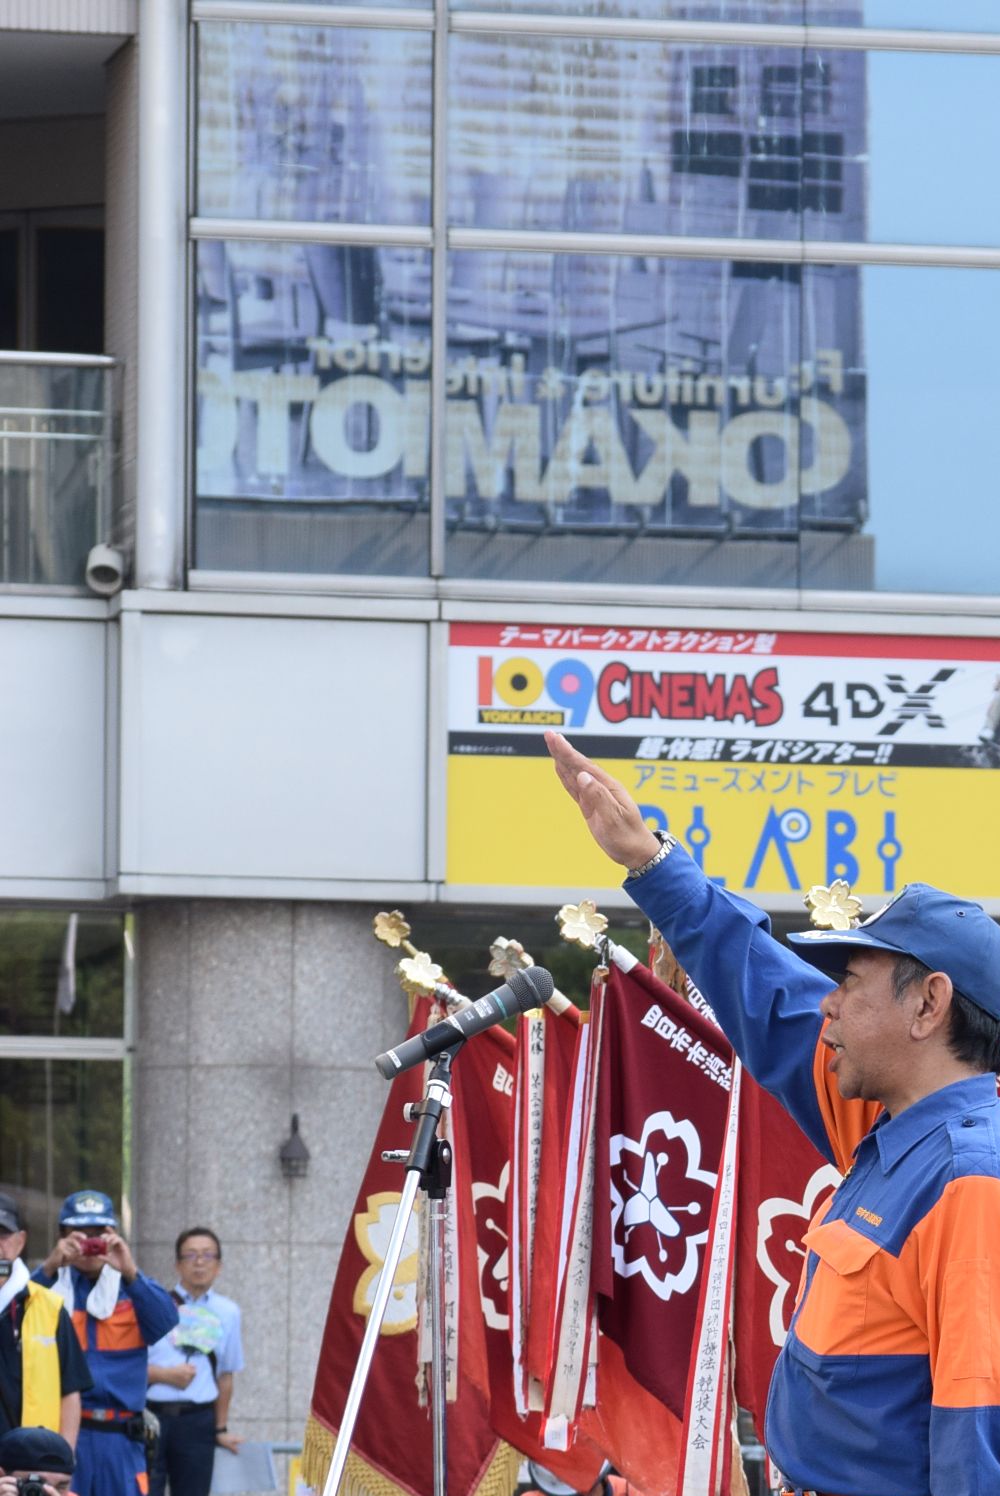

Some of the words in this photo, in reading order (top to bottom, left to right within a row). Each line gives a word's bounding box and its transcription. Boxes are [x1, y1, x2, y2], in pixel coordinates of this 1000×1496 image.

[499, 625, 777, 655] テーマパーク・アトラクション型
[478, 655, 595, 728] 109
[596, 661, 784, 727] CINEMAS
[802, 667, 960, 736] 4DX
[480, 710, 564, 725] YOKKAICHI
[634, 763, 815, 795] アミューズメント
[826, 769, 898, 798] プレビ
